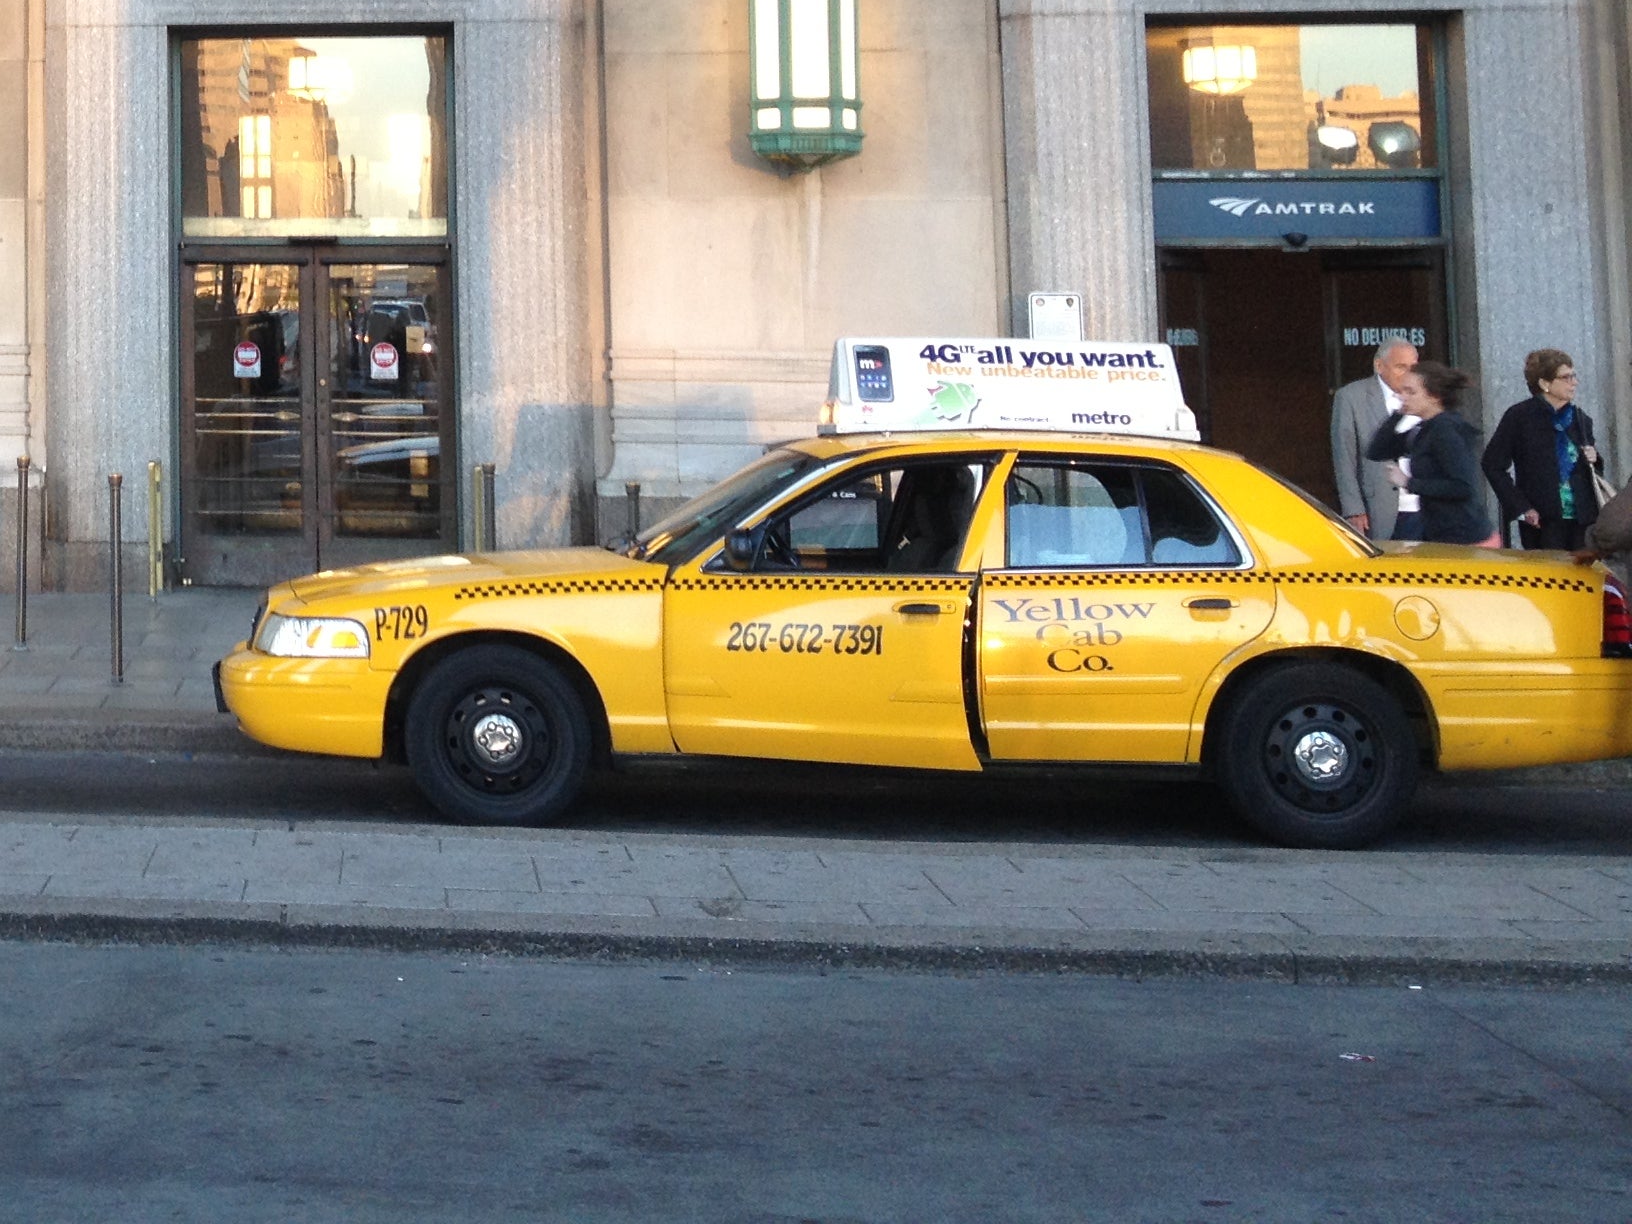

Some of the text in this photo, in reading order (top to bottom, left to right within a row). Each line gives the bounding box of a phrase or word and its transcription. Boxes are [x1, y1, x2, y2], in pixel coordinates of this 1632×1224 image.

[1254, 202, 1376, 215] AMTRAK
[1344, 327, 1426, 347] NO DELIVERES
[919, 344, 962, 364] 4G
[977, 345, 1014, 365] all
[1019, 351, 1075, 369] you
[1079, 350, 1166, 369] want.
[926, 362, 1167, 384] New unbeatable price.
[1071, 410, 1132, 426] metro
[374, 604, 428, 641] P-729
[990, 597, 1159, 623] Yellow
[726, 621, 883, 656] 267-672-7391
[1035, 622, 1124, 648] Cab
[1046, 648, 1115, 673] Co.
